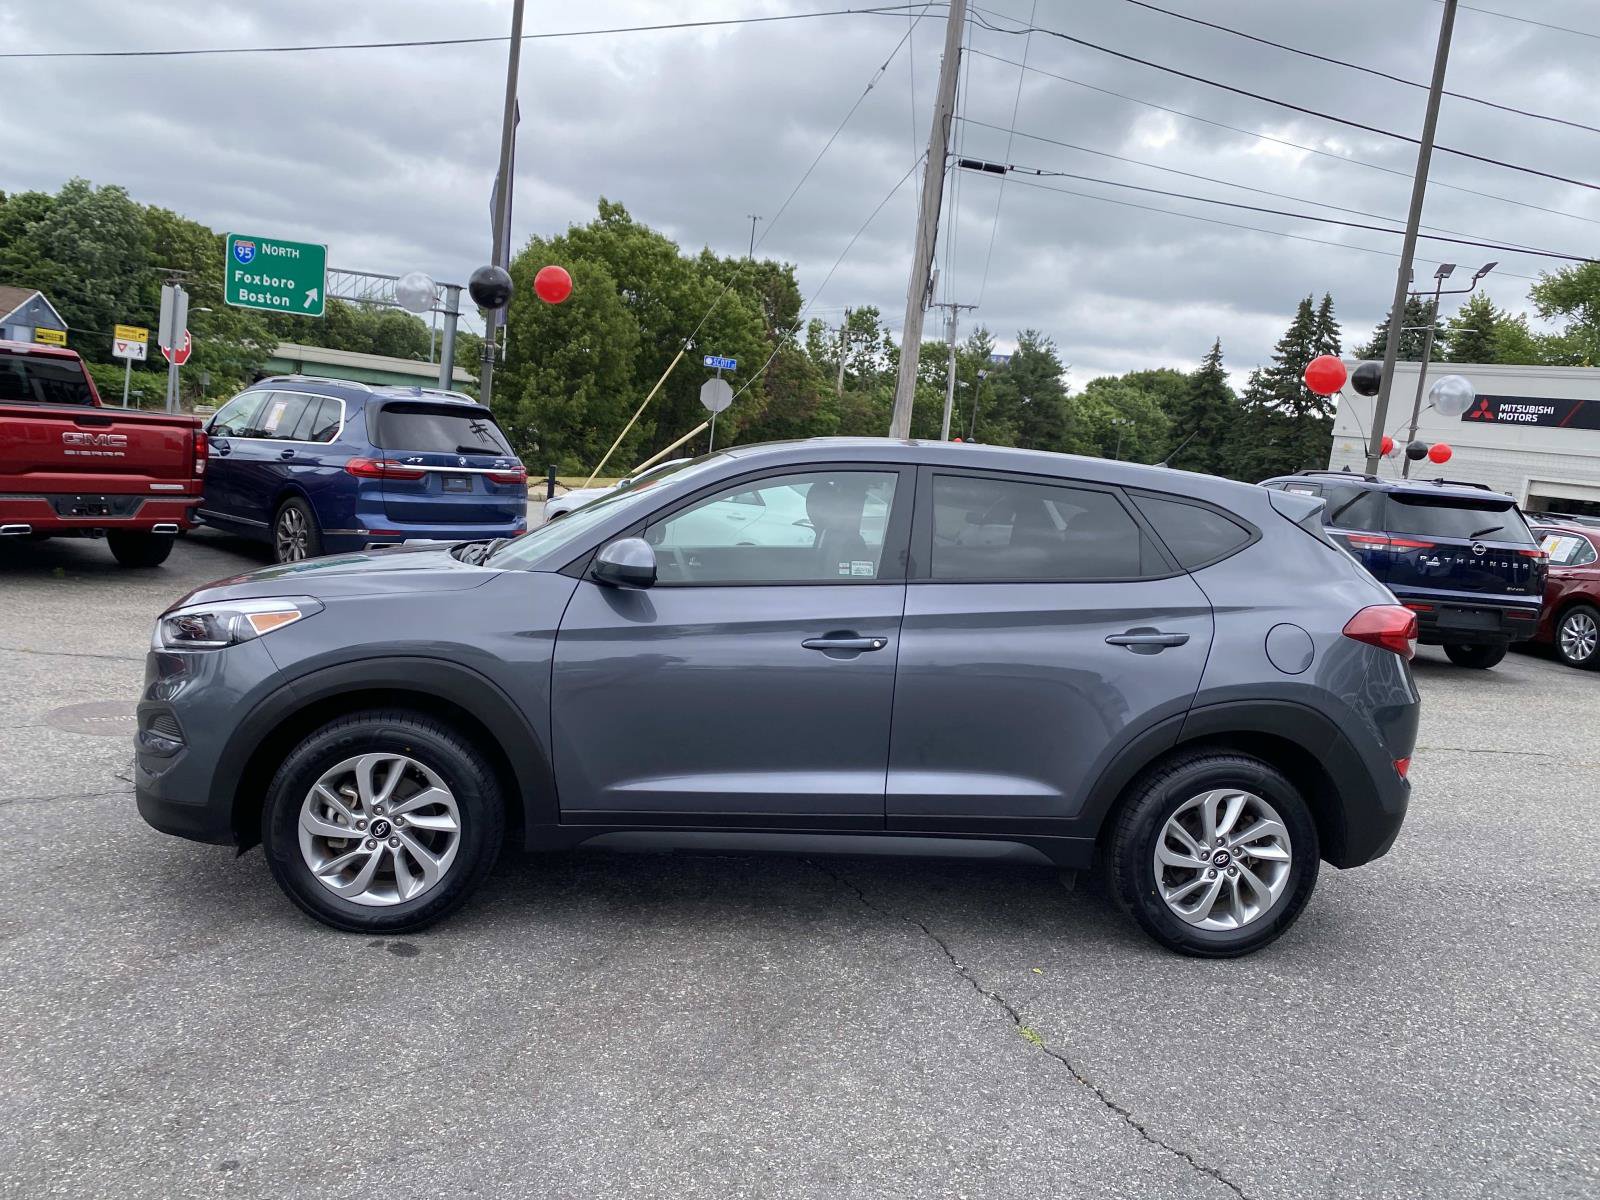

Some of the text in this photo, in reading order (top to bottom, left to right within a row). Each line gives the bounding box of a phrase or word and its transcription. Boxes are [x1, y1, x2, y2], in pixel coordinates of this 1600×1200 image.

[237, 243, 300, 259] 95 NORTH
[235, 270, 295, 289] Foxboro
[239, 288, 290, 306] Boston
[1498, 412, 1538, 422] MOTORS
[1499, 404, 1554, 415] MITSUBISHI
[62, 432, 128, 448] GMC
[1420, 555, 1529, 570] PATHFINDER
